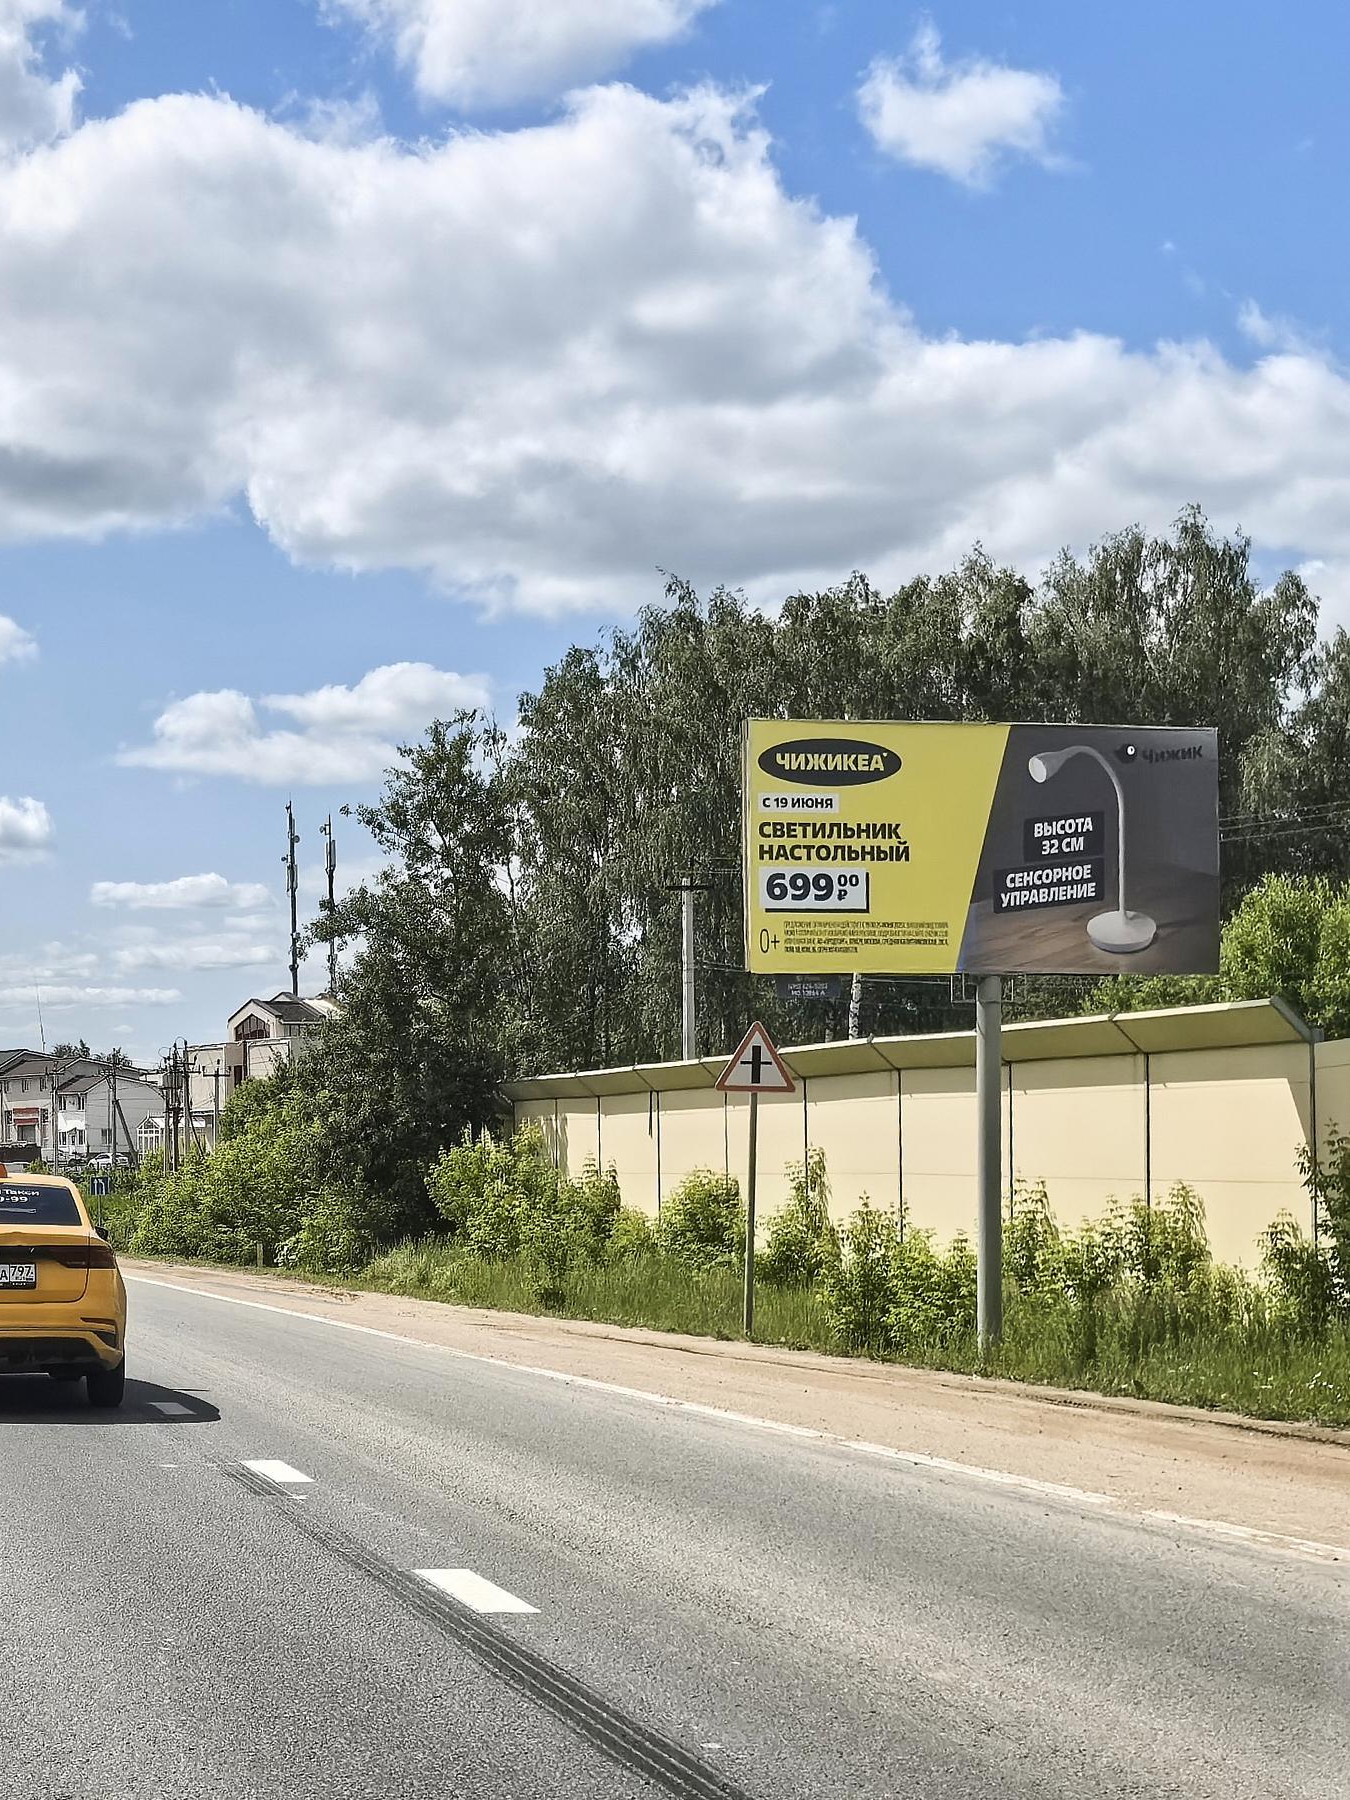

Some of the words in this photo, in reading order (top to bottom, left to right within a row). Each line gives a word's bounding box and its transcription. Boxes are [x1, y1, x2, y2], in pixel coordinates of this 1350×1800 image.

[775, 752, 885, 771] ЧИЖИКЕА
[762, 797, 771, 808] С
[774, 797, 788, 808] 19
[791, 797, 834, 808] ИЮНЯ
[758, 821, 902, 839] СВЕТИЛЬНИК
[1034, 817, 1093, 837] ВЫСОТА
[758, 840, 910, 861] НАСТОЛЬНЫЙ
[1041, 839, 1059, 855] 32
[1061, 836, 1084, 853] СМ
[1006, 864, 1092, 888] СЕНСОРНОЕ
[766, 872, 834, 901] 699
[1000, 882, 1096, 908] УПРАВЛЕНИЕ
[759, 928, 780, 953] 0+
[10, 1265, 31, 1277] 797
